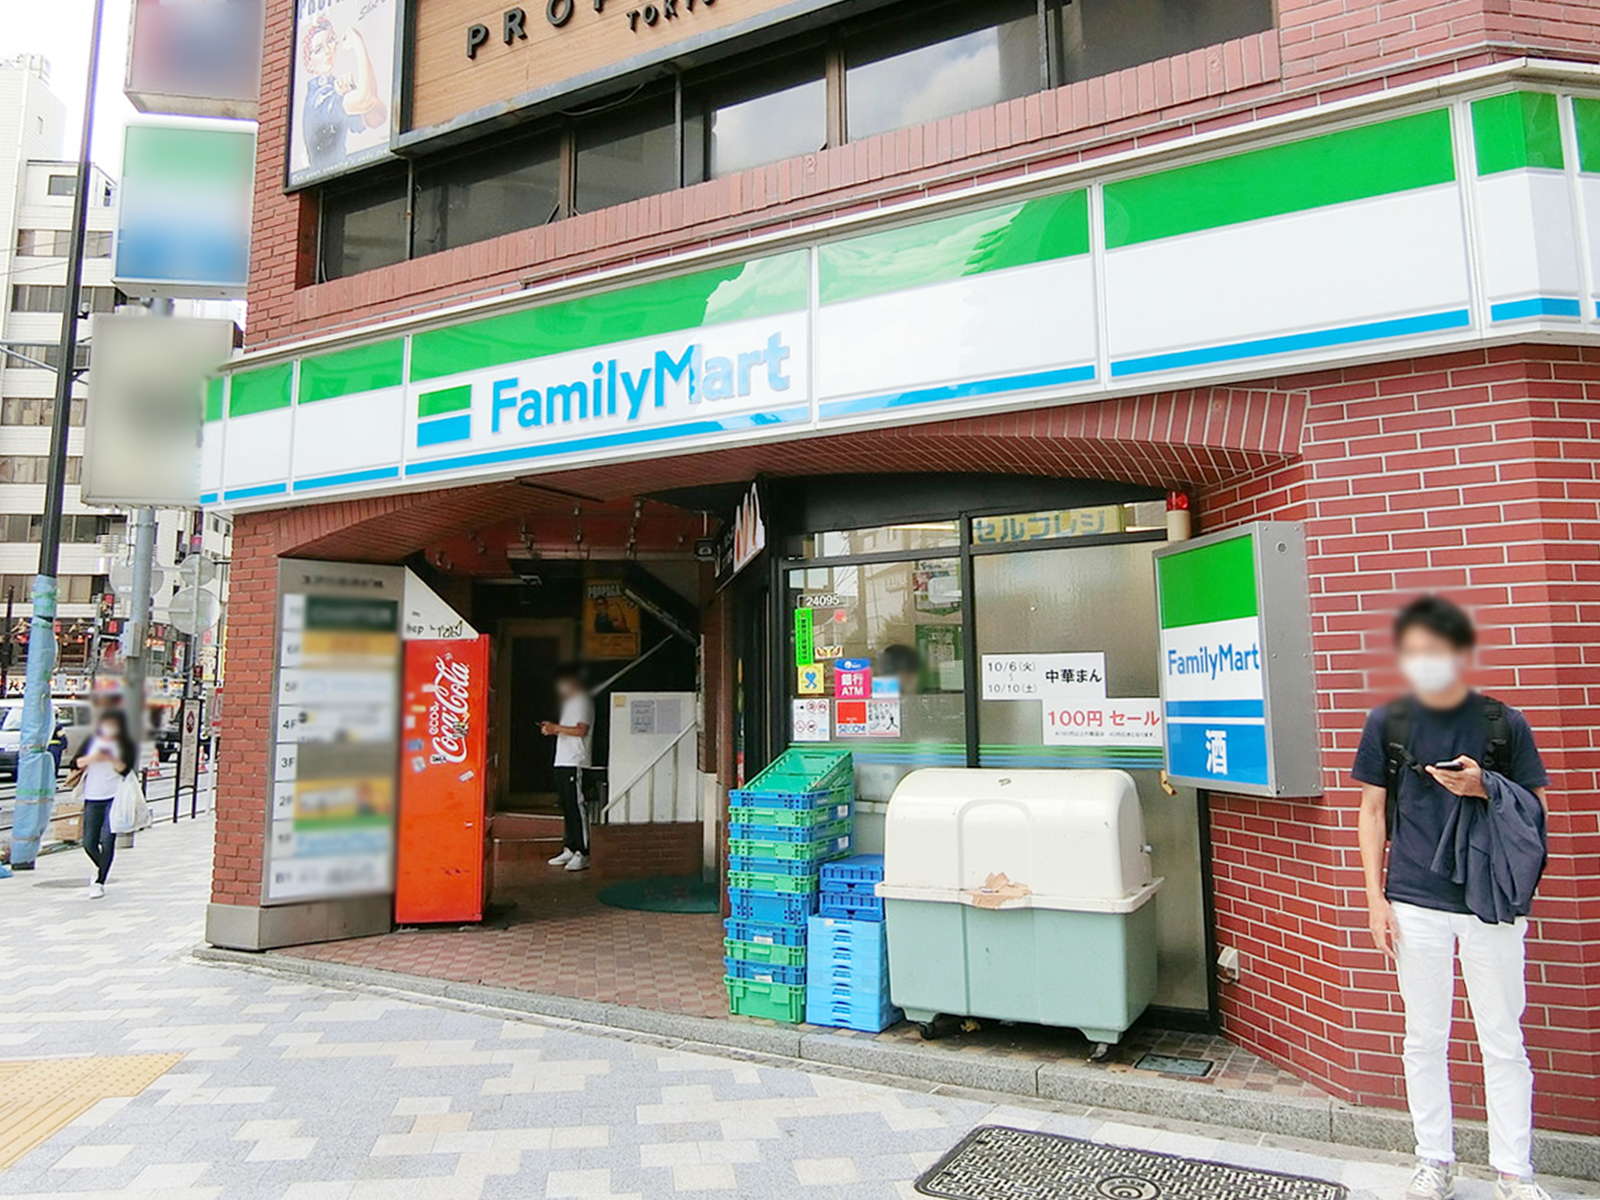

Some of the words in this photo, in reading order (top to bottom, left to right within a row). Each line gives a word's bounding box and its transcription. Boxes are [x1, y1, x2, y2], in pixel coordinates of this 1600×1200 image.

[626, 0, 716, 32] TOK
[492, 332, 789, 433] FamilyMart
[806, 595, 840, 606] 24095
[1168, 643, 1259, 680] FamilyMart
[841, 673, 864, 686] 銀行
[1045, 669, 1102, 684] 中華まん
[841, 686, 864, 696] ATM
[282, 719, 298, 730] 4F
[1048, 710, 1103, 727] 100円
[1109, 710, 1161, 727] セール
[1205, 729, 1228, 775] 酒
[281, 757, 295, 768] 3F
[279, 796, 293, 807] 2F
